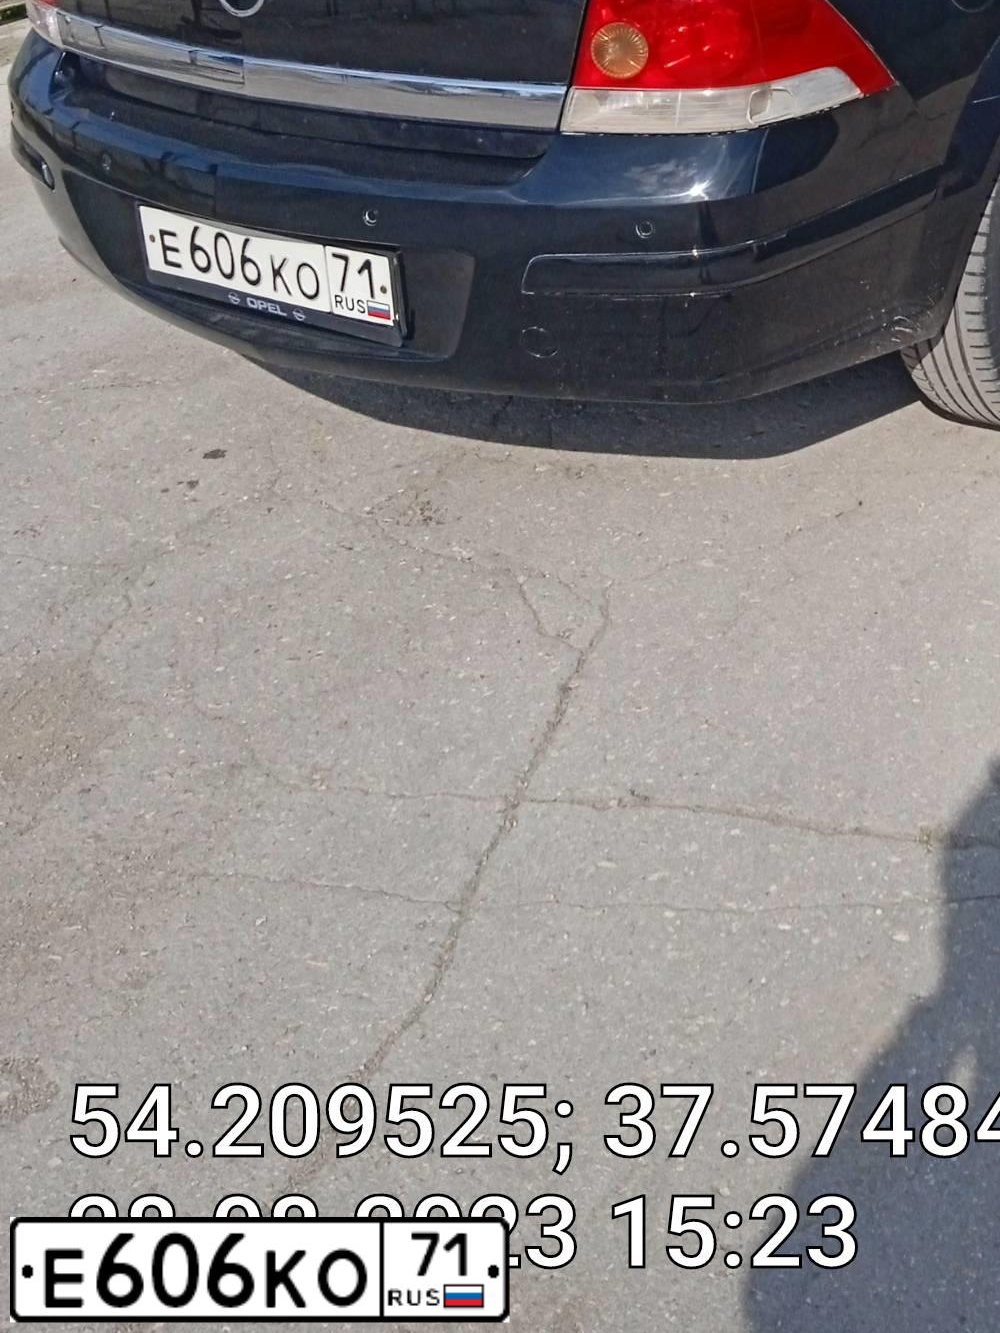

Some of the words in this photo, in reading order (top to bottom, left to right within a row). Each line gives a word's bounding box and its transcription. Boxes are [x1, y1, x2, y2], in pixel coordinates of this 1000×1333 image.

[159, 226, 320, 300] Е606КО
[332, 253, 375, 299] 71
[246, 296, 287, 316] OPEL
[335, 294, 366, 314] RUS
